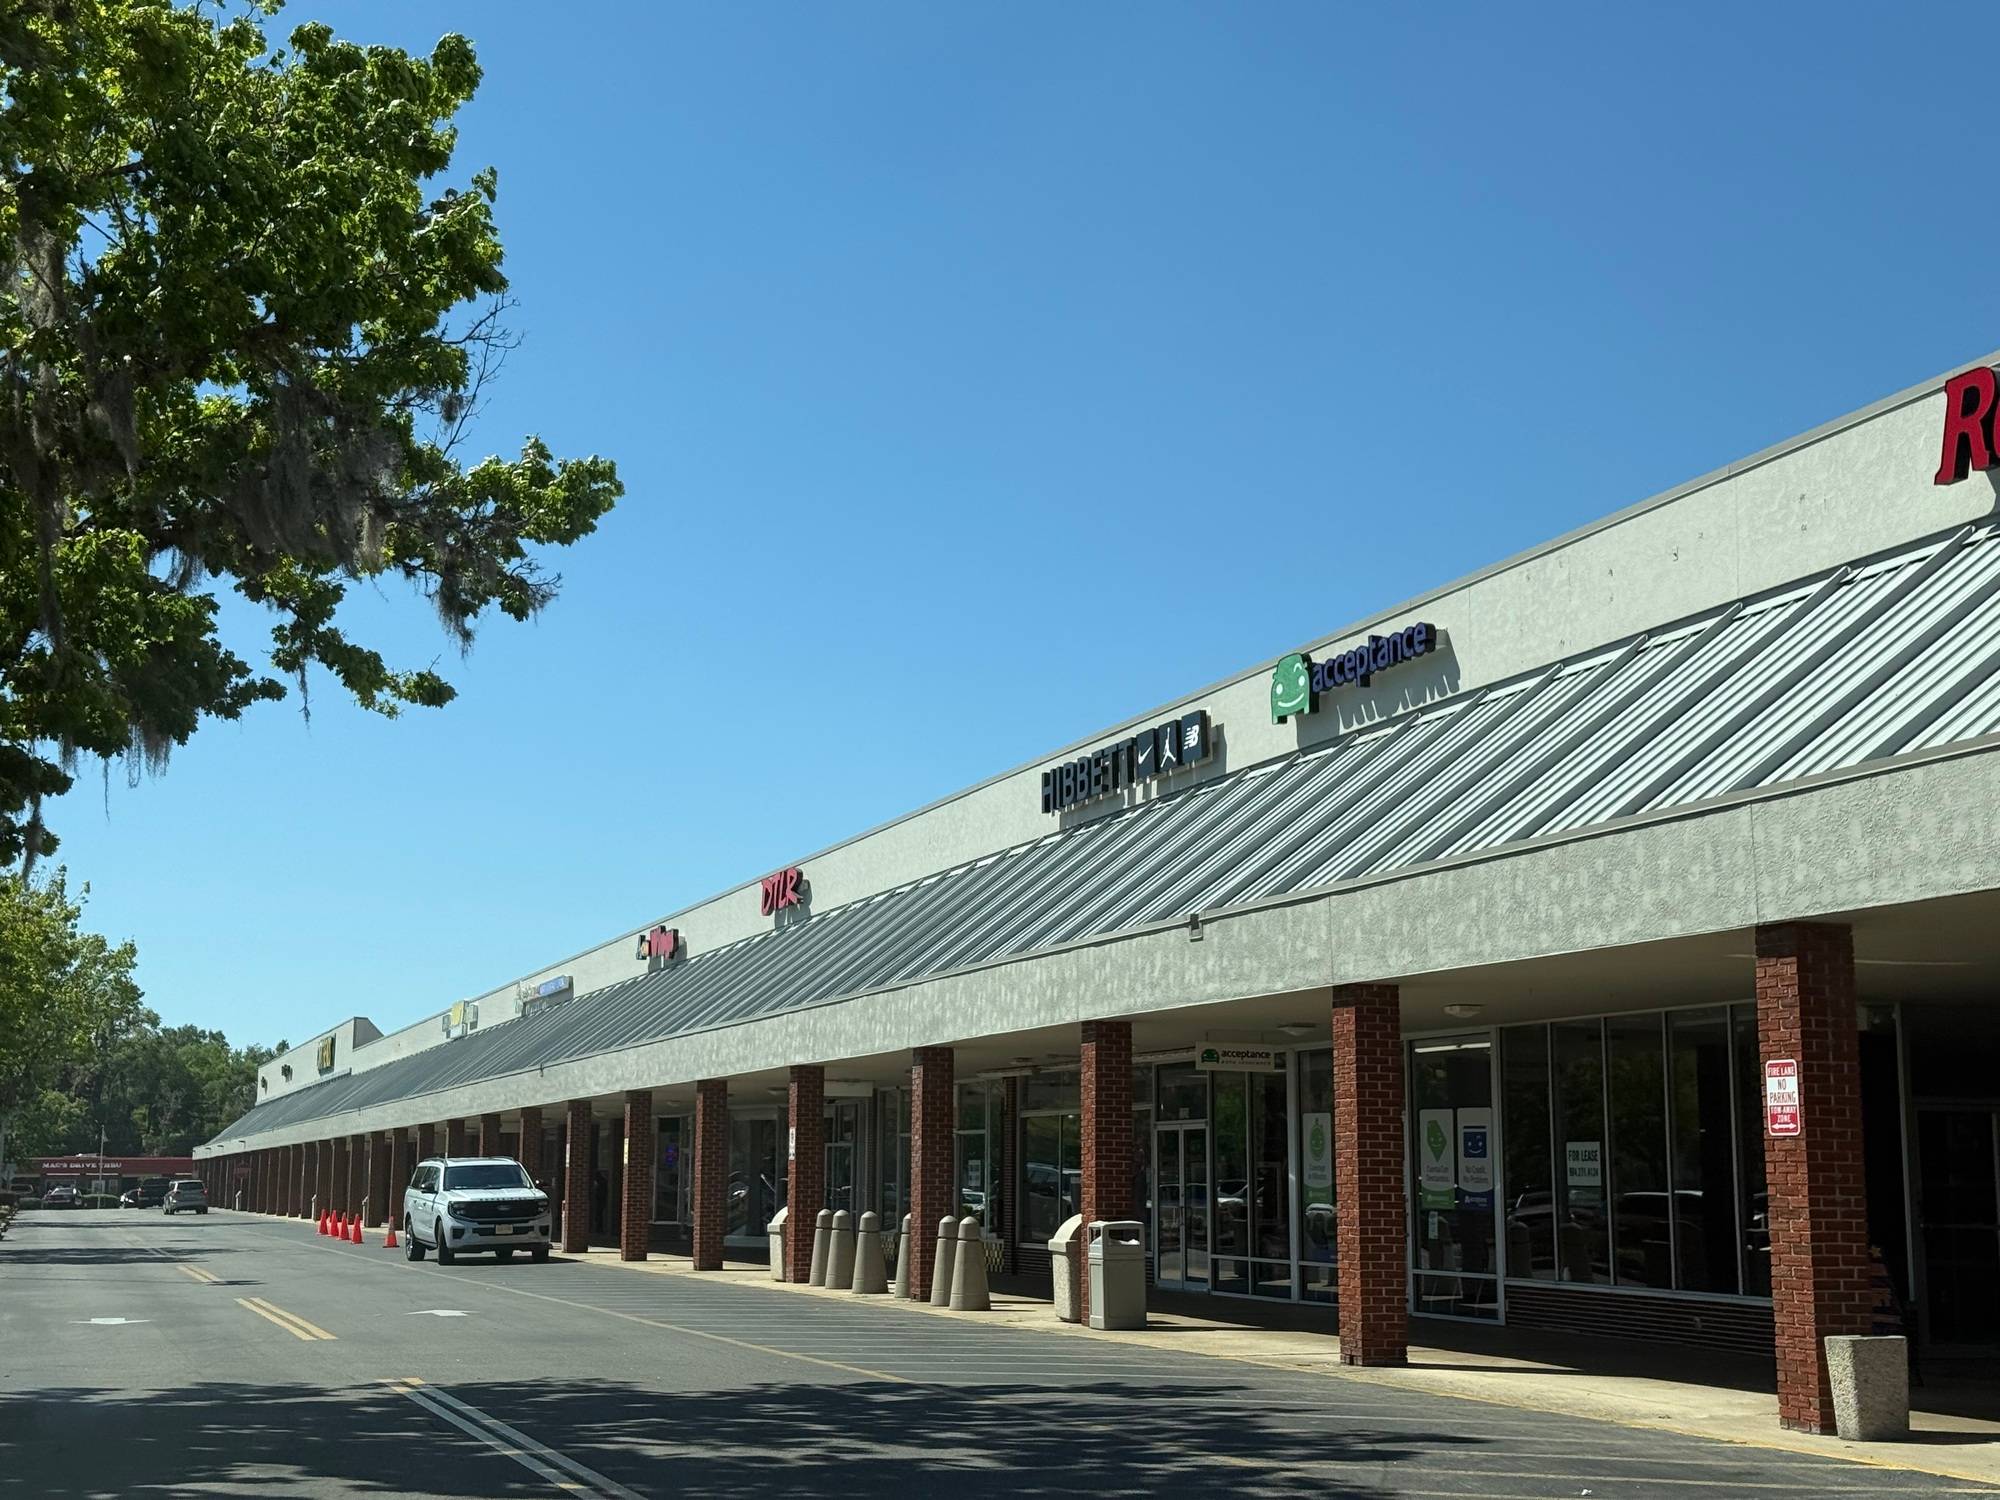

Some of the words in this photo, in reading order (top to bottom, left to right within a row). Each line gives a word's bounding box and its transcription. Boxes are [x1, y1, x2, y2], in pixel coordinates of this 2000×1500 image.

[1934, 366, 2000, 485] R
[1312, 622, 1429, 693] acceptance
[1042, 737, 1134, 813] HIBBETT
[761, 867, 804, 916] DTLR
[1221, 1050, 1271, 1060] acceptance
[1768, 1067, 1780, 1075] FIRE
[1781, 1066, 1795, 1075] LANE
[1777, 1078, 1787, 1090] NO
[1769, 1091, 1796, 1103] PARKING
[1777, 1114, 1791, 1122] ZONE
[1568, 1150, 1579, 1161] FOR
[1581, 1150, 1599, 1161] LEASE
